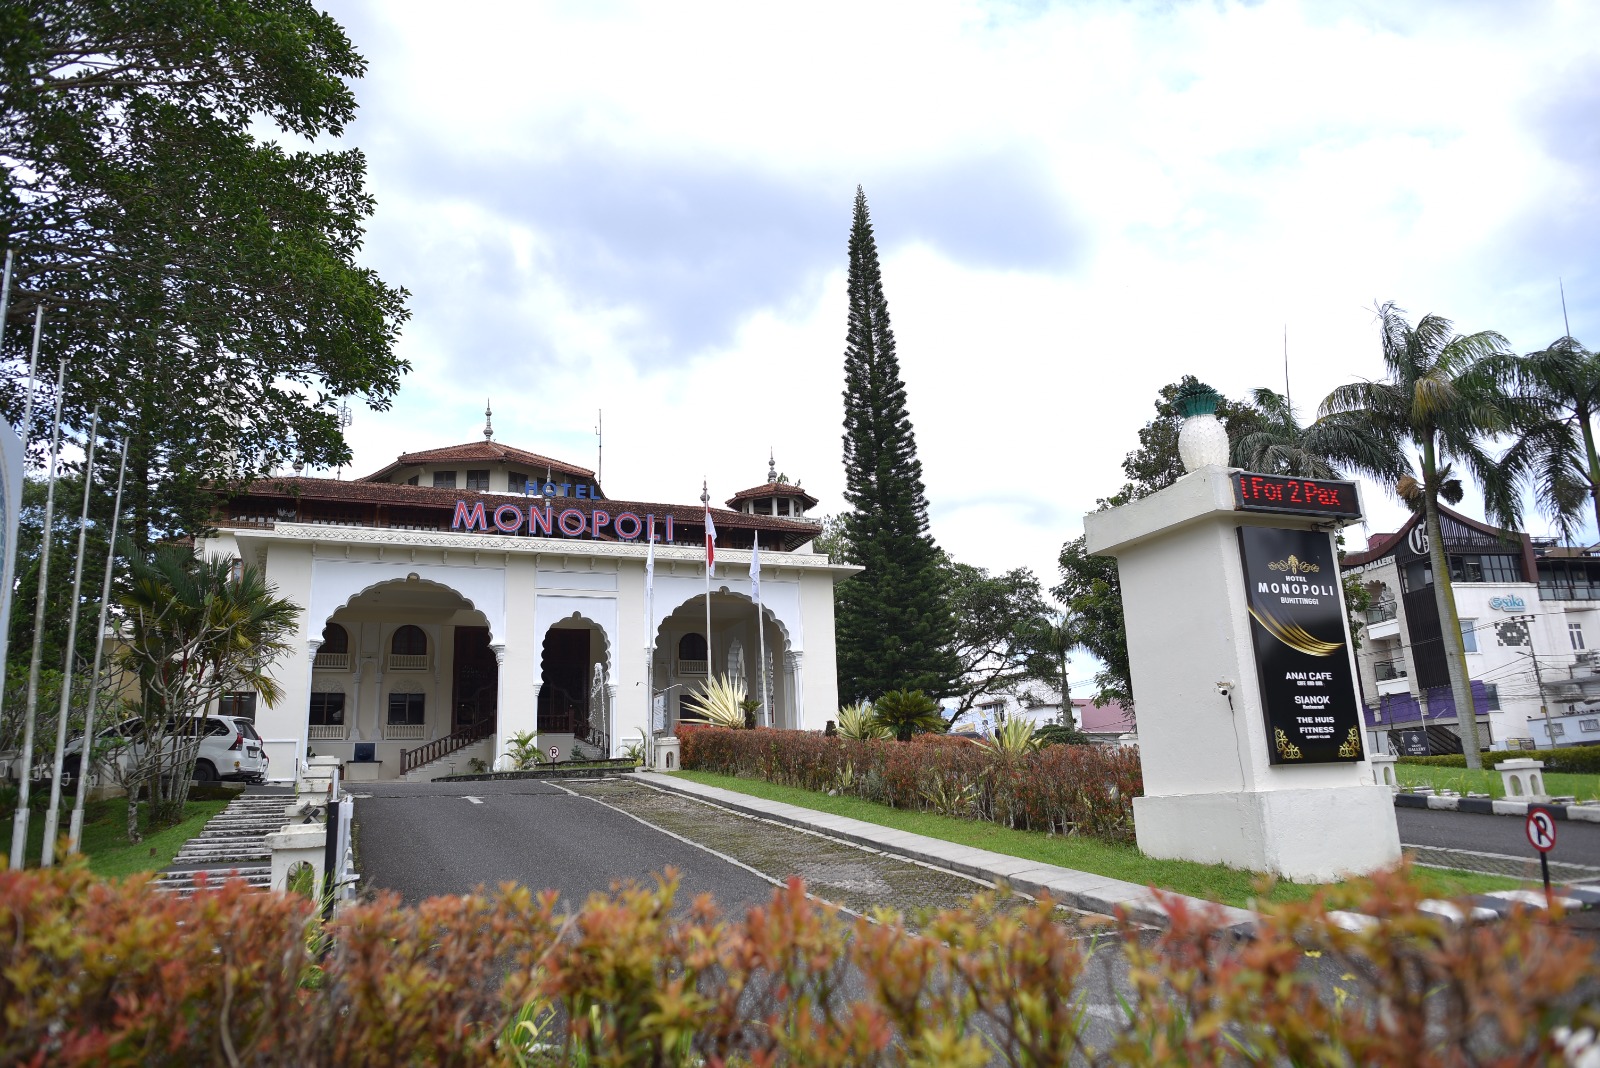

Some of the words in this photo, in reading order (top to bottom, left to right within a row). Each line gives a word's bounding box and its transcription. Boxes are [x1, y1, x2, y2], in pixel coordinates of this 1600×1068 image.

[525, 480, 601, 500] HOTEL
[1251, 477, 1284, 501] For
[1287, 480, 1302, 502] 2
[1303, 482, 1341, 506] Pax
[451, 499, 674, 542] MONOPOLI
[1364, 554, 1397, 571] GALLERY
[1258, 582, 1334, 596] MONOPOLI
[1285, 671, 1307, 680] ANAI
[1308, 672, 1333, 681] CAFE
[1294, 695, 1331, 704] SIANOK
[1296, 716, 1314, 724] THE
[1314, 716, 1335, 724] HUIS
[1299, 726, 1335, 734] FITNESS
